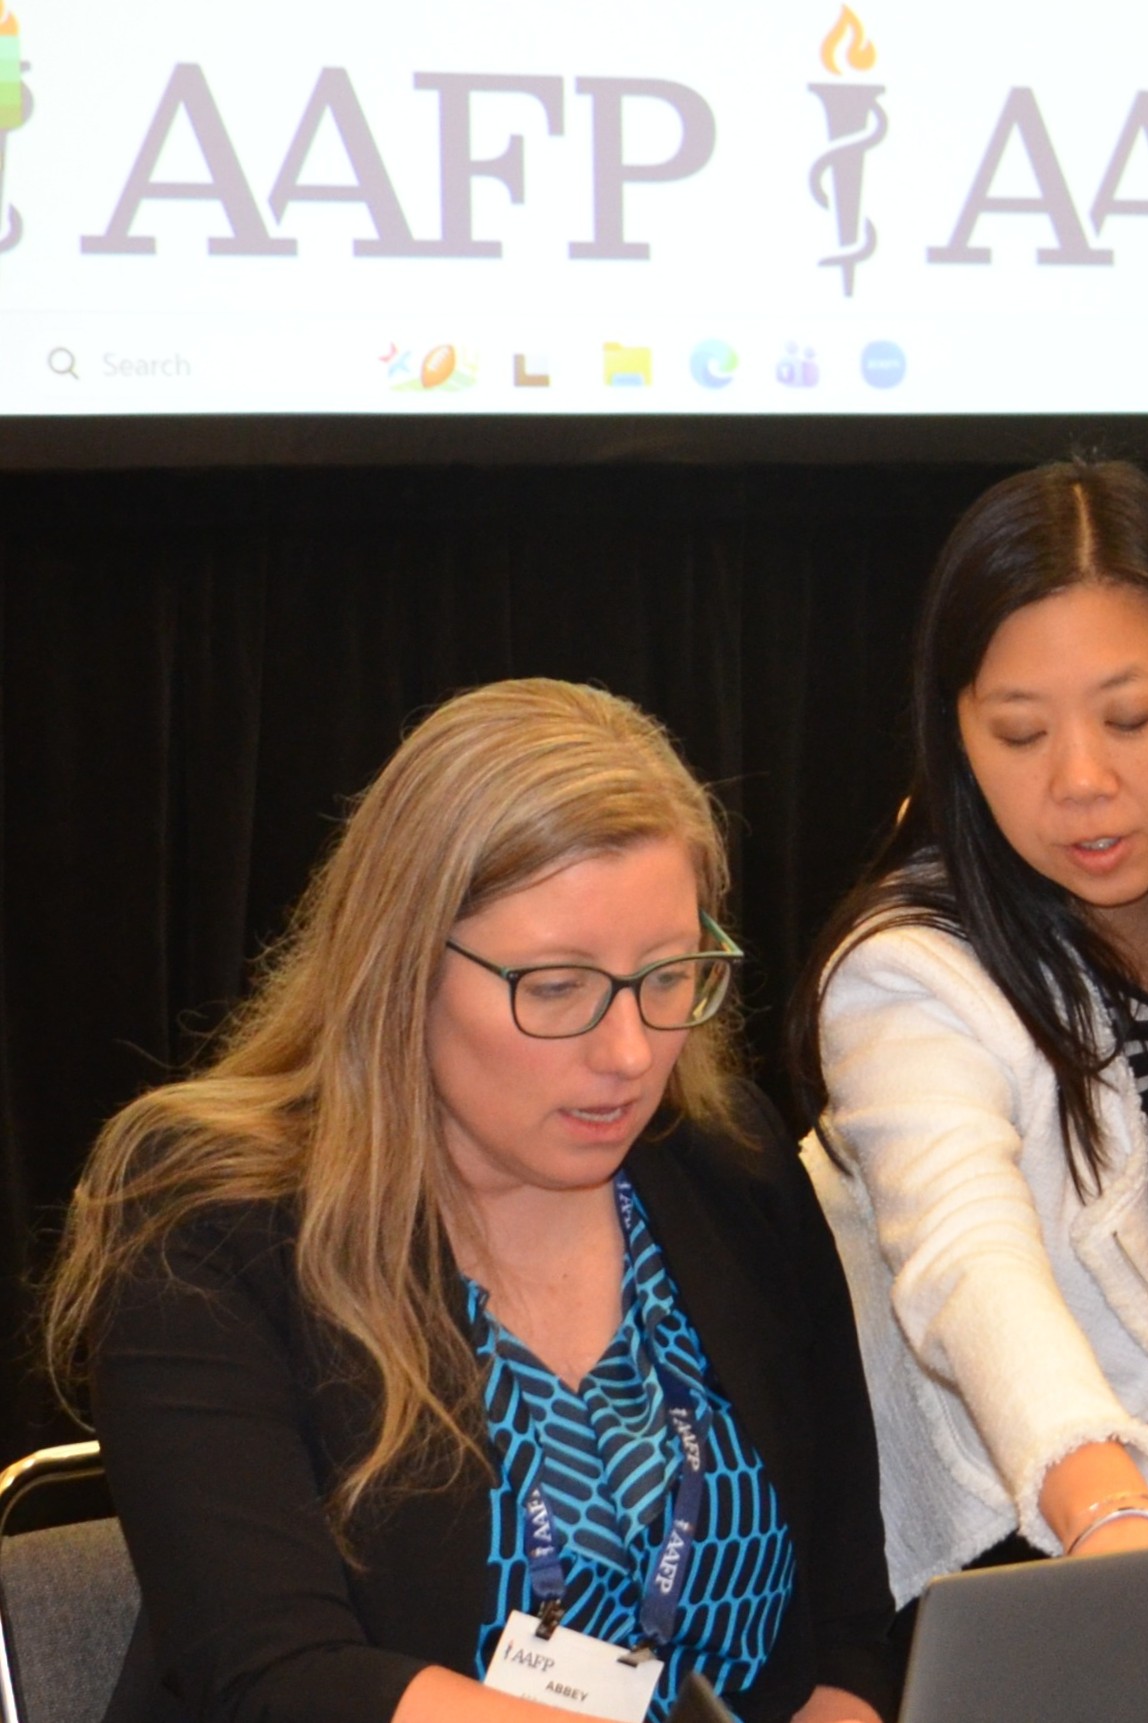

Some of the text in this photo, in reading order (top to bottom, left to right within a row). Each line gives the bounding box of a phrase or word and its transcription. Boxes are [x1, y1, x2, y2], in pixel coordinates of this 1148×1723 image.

[79, 61, 717, 261] AAFP
[102, 351, 193, 378] Search
[672, 1415, 701, 1472] AAFP
[655, 1530, 686, 1595] AAFP
[511, 1648, 555, 1673] AAFP
[545, 1680, 589, 1703] ABBEY
